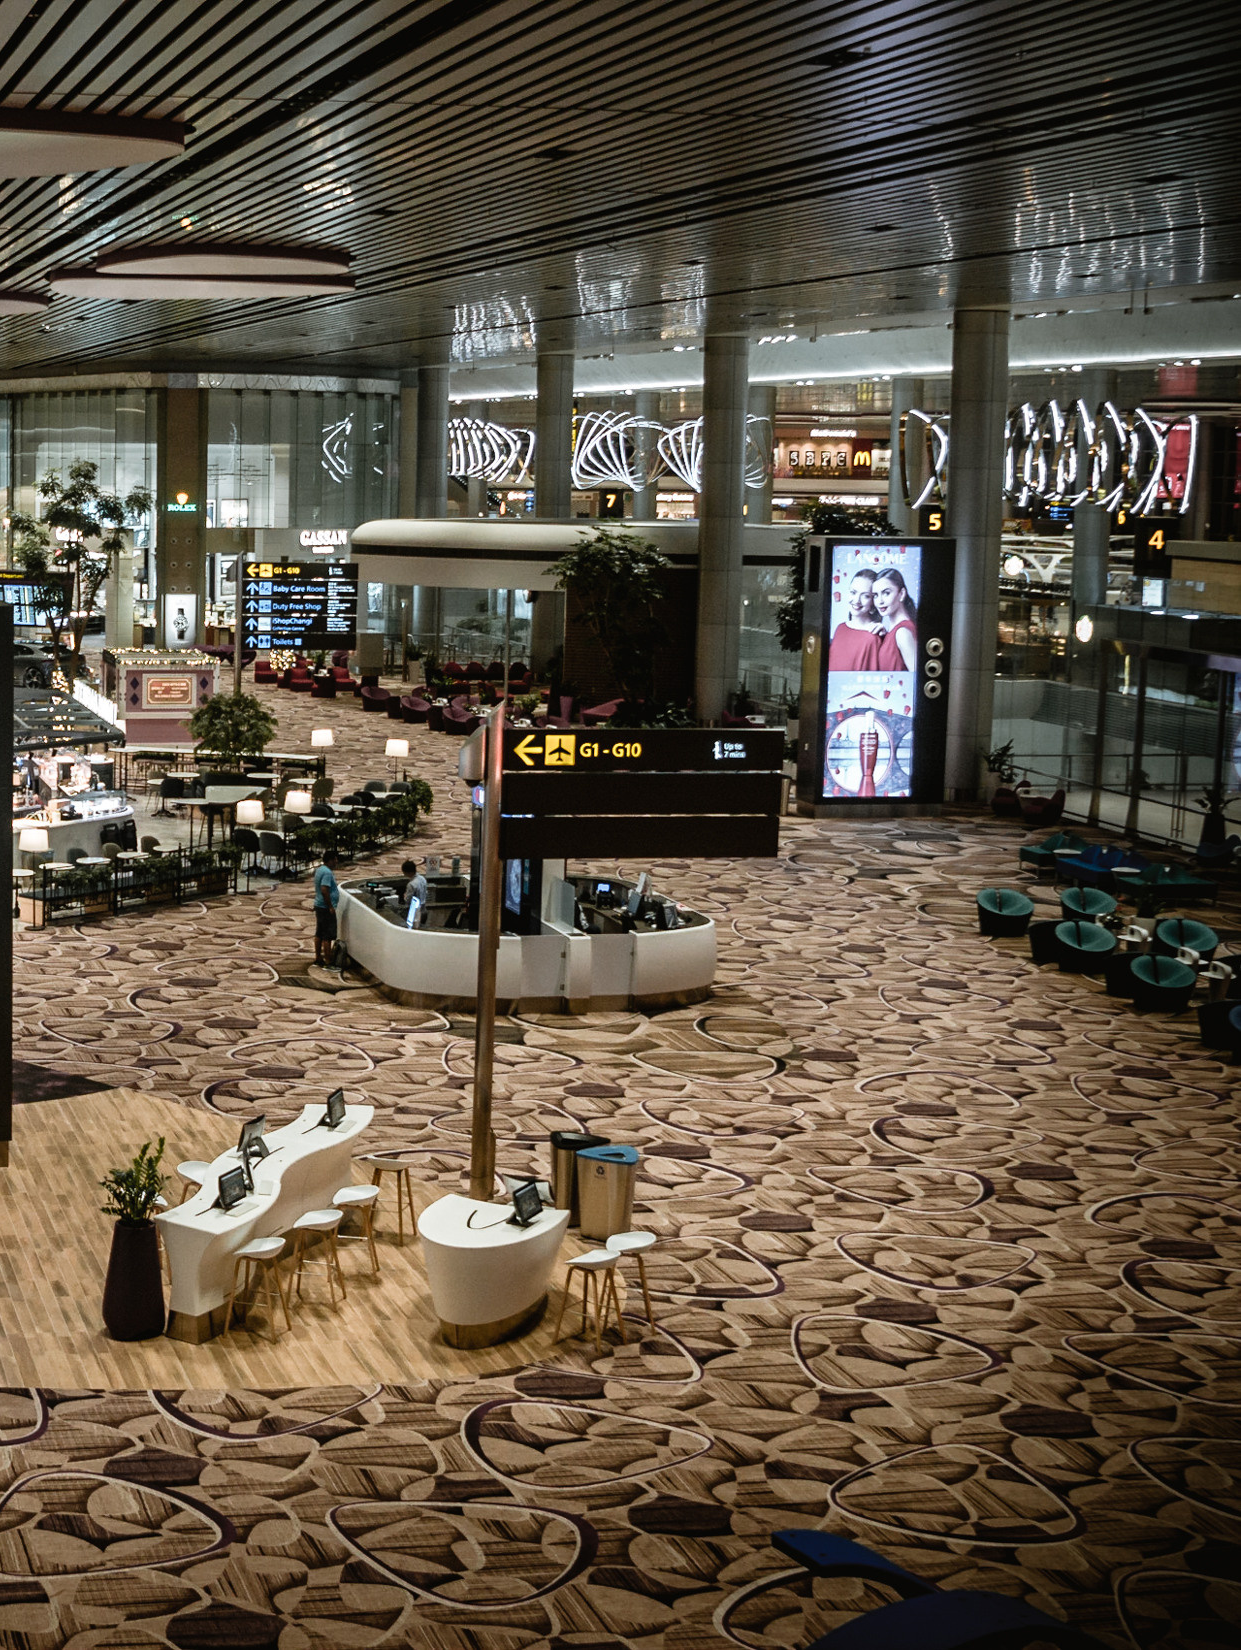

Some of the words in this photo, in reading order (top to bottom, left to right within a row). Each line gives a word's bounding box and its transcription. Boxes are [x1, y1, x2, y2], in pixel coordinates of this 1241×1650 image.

[606, 494, 616, 508] 7
[929, 514, 941, 530] 5
[1118, 511, 1126, 524] 6
[1148, 530, 1164, 549] 4
[580, 743, 599, 758] G1
[612, 742, 642, 758] G10
